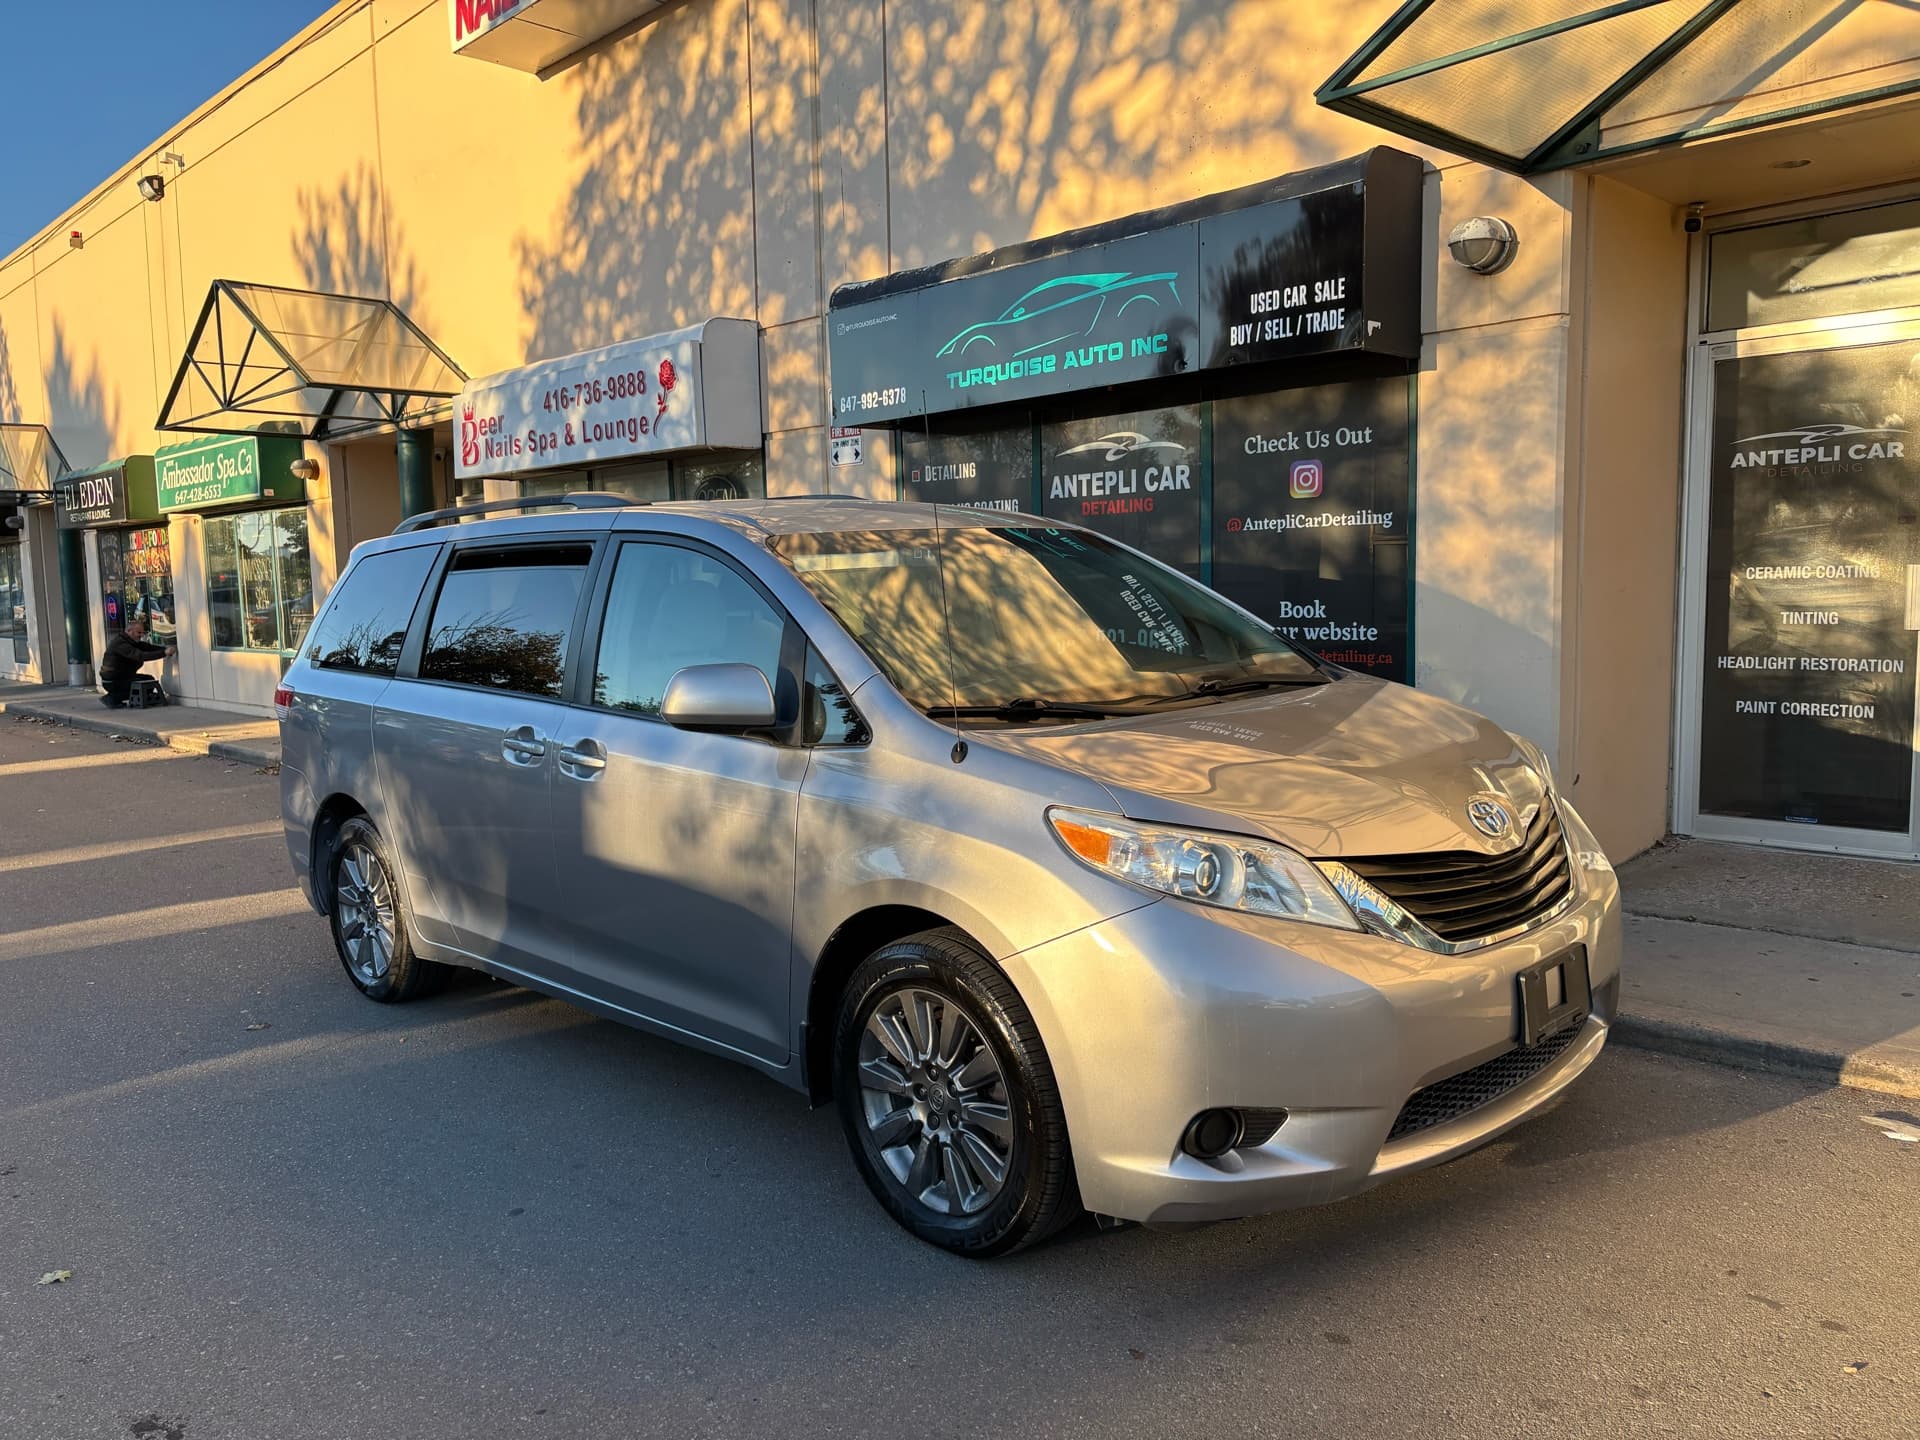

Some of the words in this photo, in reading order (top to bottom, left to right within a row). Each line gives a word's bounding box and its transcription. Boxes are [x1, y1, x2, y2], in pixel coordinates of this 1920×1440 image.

[1250, 289, 1280, 315] USED
[1283, 284, 1307, 309] CAR
[1314, 277, 1346, 303] SALE
[1230, 323, 1253, 347] BUY
[1255, 321, 1262, 343] /
[1264, 316, 1293, 341] SELL
[1296, 314, 1302, 336] /
[1305, 308, 1345, 335] TRADE
[1063, 341, 1124, 370] AUTO
[1131, 333, 1168, 358] INC
[543, 370, 647, 414] 416-736-9888
[840, 387, 907, 413] 647-992-6378
[484, 436, 522, 460] Nails
[527, 429, 558, 457] Spa
[564, 422, 576, 446] &
[582, 414, 650, 444] Lounge
[831, 427, 843, 438] FIRE
[845, 426, 861, 436] ROUTE
[1244, 431, 1300, 455] Check
[1305, 430, 1330, 449] Us
[1335, 426, 1373, 446] Out
[1730, 445, 1841, 469] ANTEPLI
[1848, 441, 1905, 460] CAR
[161, 456, 215, 490] Ambassador
[925, 463, 976, 482] DETAILING
[1767, 462, 1864, 478] DETAILING
[1050, 468, 1137, 500] ANTEPLI
[1144, 464, 1191, 492] CAR
[64, 484, 80, 511] EL
[79, 476, 114, 509] EDEN
[175, 484, 222, 504] 647-428-6553
[1082, 498, 1154, 516] DETAILING
[1226, 510, 1394, 533] @AntepliCarDetailing
[1746, 566, 1812, 580] CERAMIC
[1816, 565, 1880, 579] COATING
[1279, 599, 1327, 619] Book
[1780, 611, 1839, 625] TINTING
[1302, 621, 1379, 641] website
[1318, 649, 1393, 667] detailing.ca
[1717, 656, 1797, 670] HEADLIGHT
[1799, 657, 1905, 673] RESTORATION
[1735, 700, 1777, 714] PAINT
[1780, 702, 1875, 719] CORRECTION
